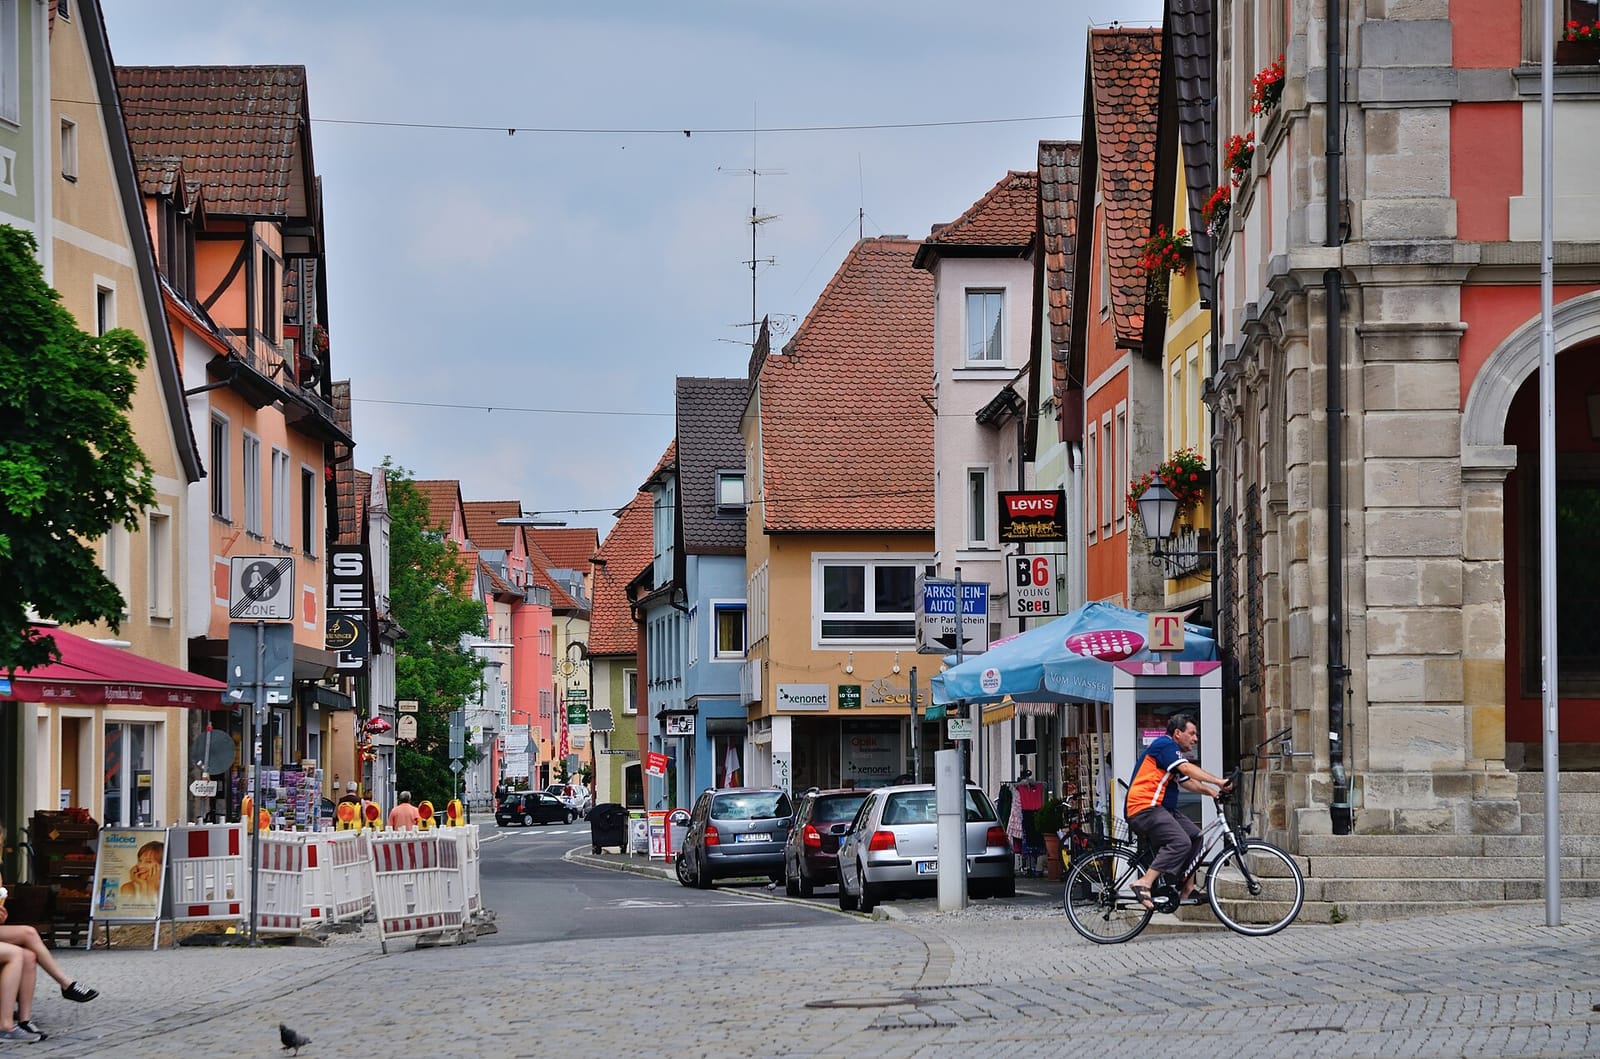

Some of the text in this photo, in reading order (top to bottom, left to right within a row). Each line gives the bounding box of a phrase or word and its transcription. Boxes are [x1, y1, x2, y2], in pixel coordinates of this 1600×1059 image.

[1016, 557, 1049, 587] B6
[923, 585, 985, 599] PARKSCEIN-
[1017, 589, 1050, 597] YOUNG
[245, 605, 276, 616] ZONE
[930, 600, 975, 612] AUTOAT
[1017, 598, 1050, 613] Seeg
[940, 615, 985, 625] Parchein
[1154, 616, 1180, 647] T
[789, 693, 826, 704] xenonet
[857, 766, 891, 775] xenonet
